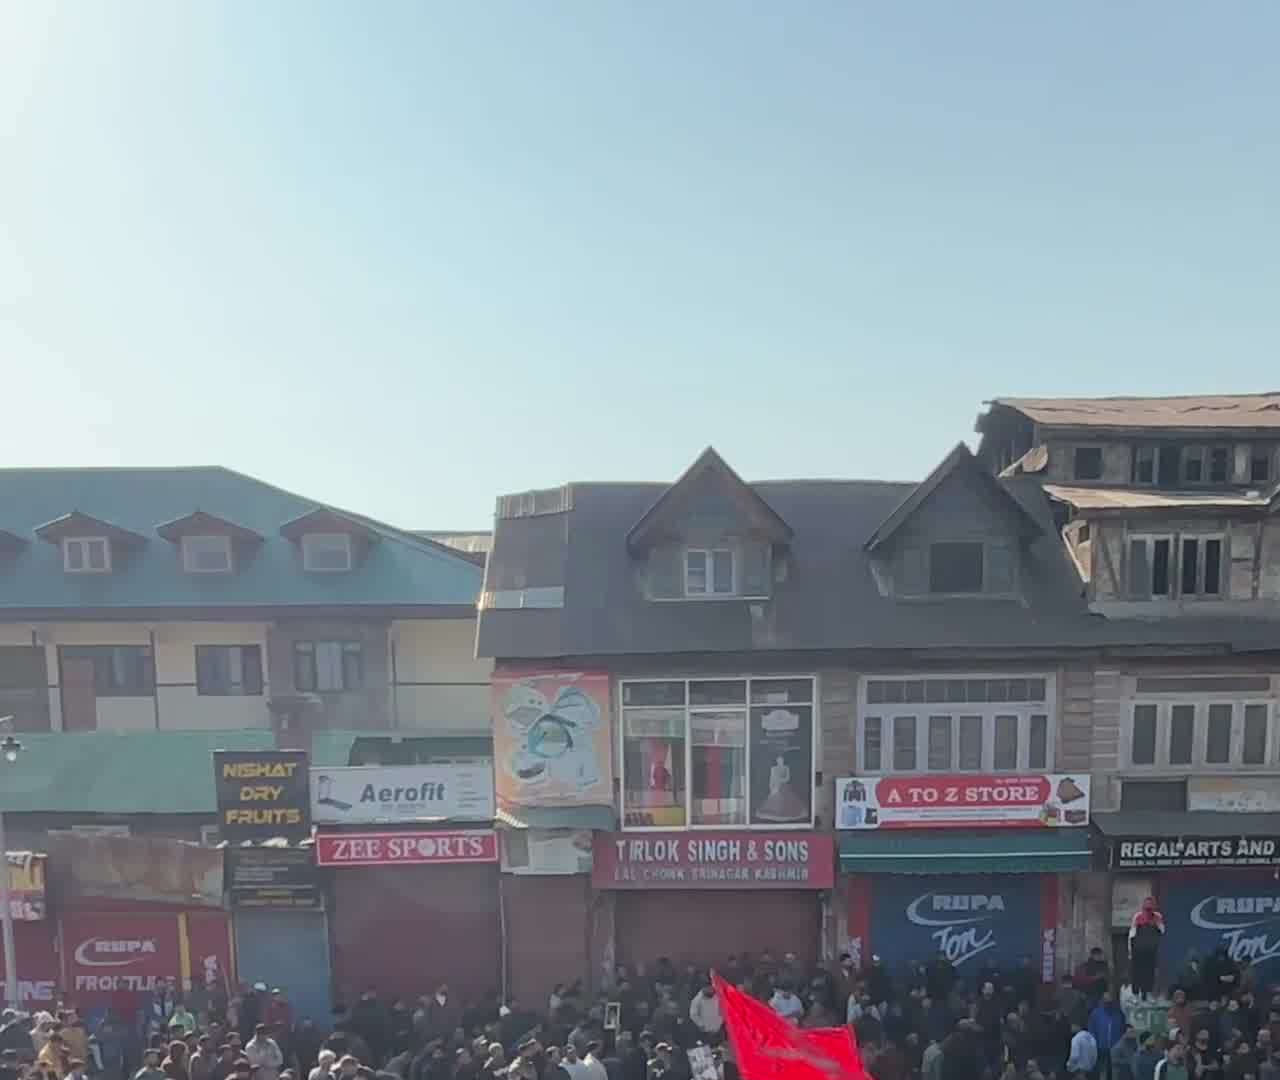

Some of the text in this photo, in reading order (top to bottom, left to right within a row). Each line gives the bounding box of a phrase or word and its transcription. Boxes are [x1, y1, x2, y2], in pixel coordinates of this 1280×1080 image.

[222, 762, 297, 778] NISHAT
[239, 785, 284, 801] DRY
[359, 781, 446, 804] Aerofit
[887, 785, 1040, 803] A TO Z STORE
[224, 808, 302, 825] FRUITS
[331, 838, 384, 860] ZEE
[687, 839, 740, 862] SINGH
[746, 840, 758, 862] &
[764, 840, 809, 863] SONS
[1120, 841, 1180, 858] REGAL
[1183, 840, 1232, 857] ARTS
[1236, 839, 1275, 857] AND
[931, 894, 1006, 911] RUPA
[95, 939, 157, 953] RUPA
